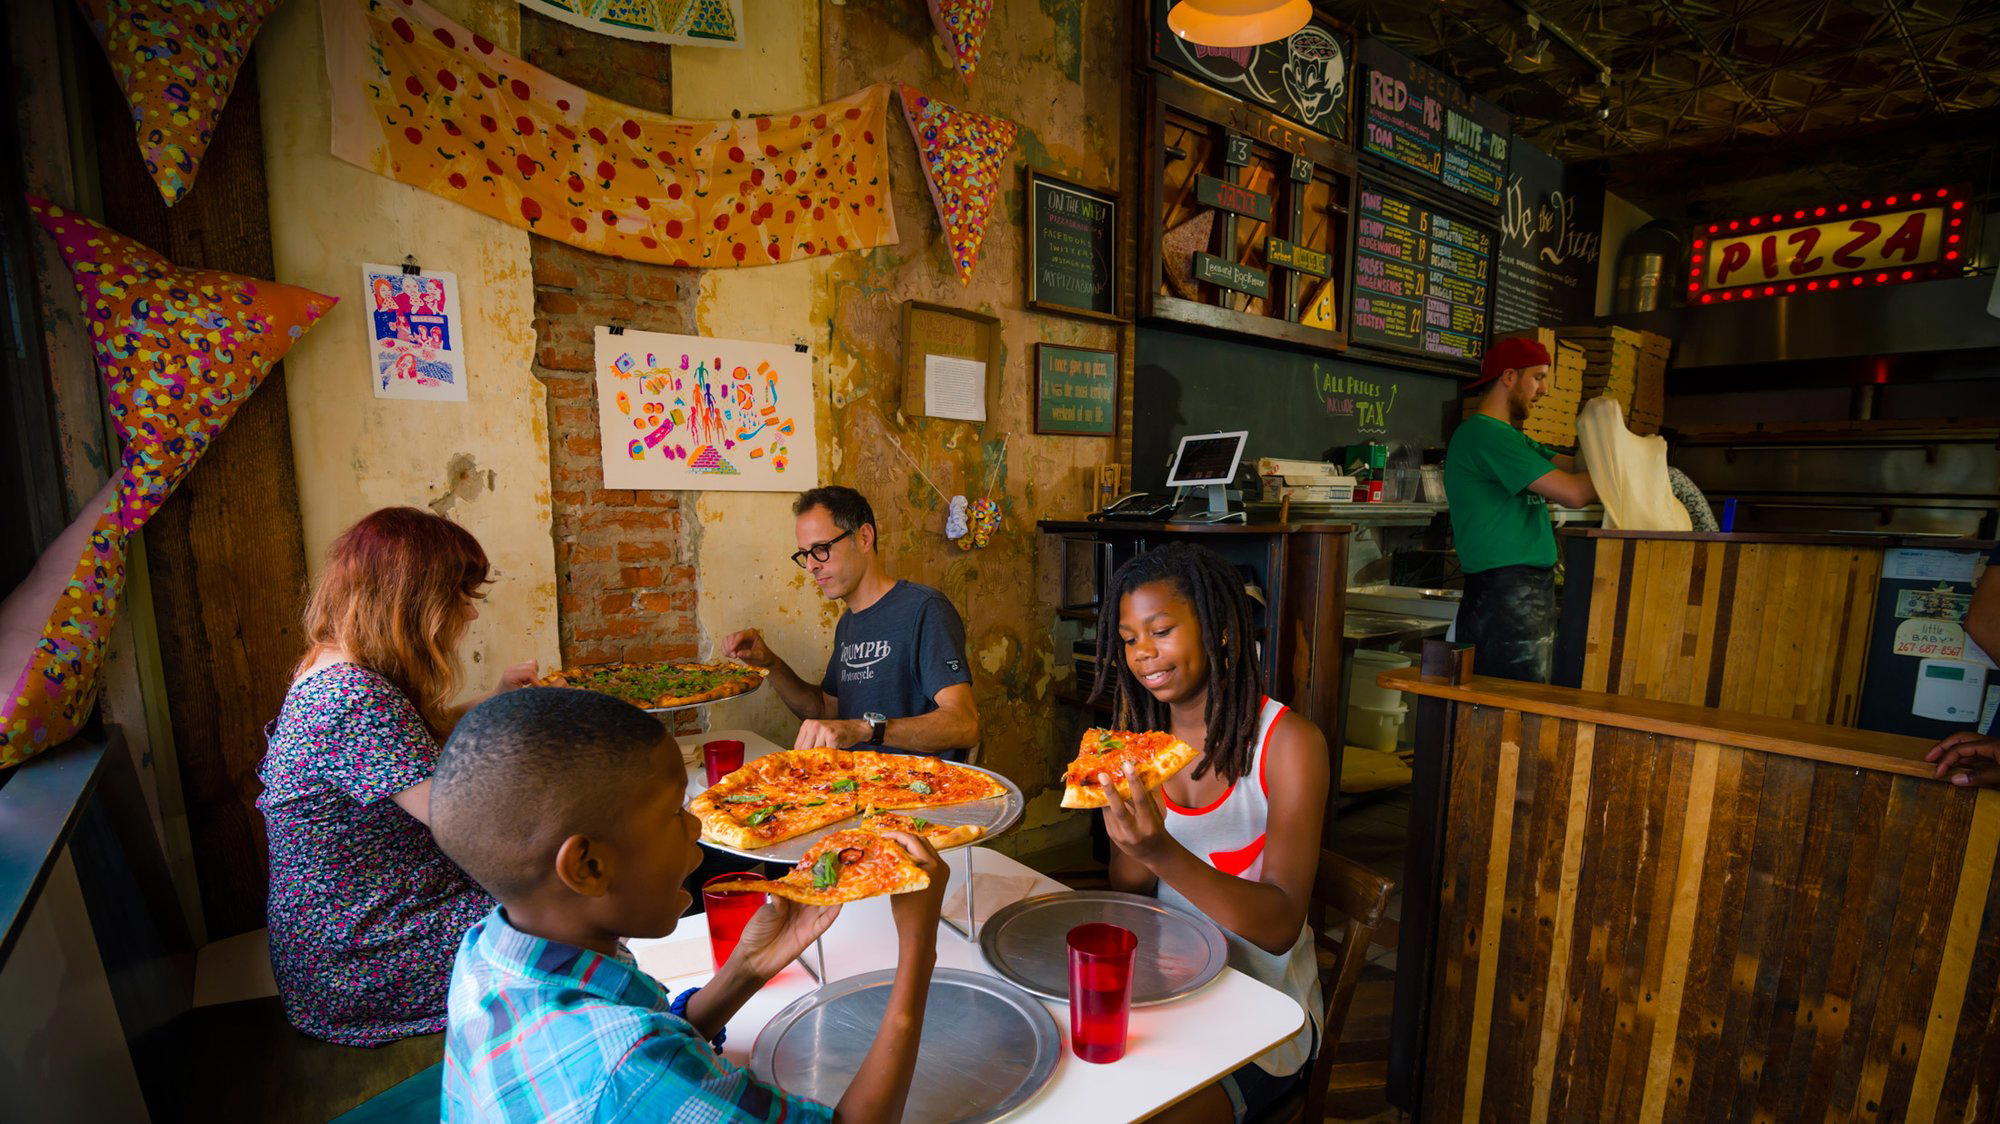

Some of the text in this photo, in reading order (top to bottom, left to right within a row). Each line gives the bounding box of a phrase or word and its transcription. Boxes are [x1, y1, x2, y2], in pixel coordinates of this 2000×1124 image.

[1370, 70, 1407, 112] RED
[1228, 107, 1306, 156] SLICES
[1368, 123, 1393, 150] TOM
[1447, 109, 1483, 152] WHITE
[1232, 140, 1247, 162] $3
[1048, 190, 1064, 211] ON
[1066, 195, 1079, 213] THE
[1501, 172, 1537, 248] We
[1717, 212, 1926, 285] PIZZA
[1324, 372, 1381, 397] ALL PRICES
[1355, 401, 1385, 427] TAX
